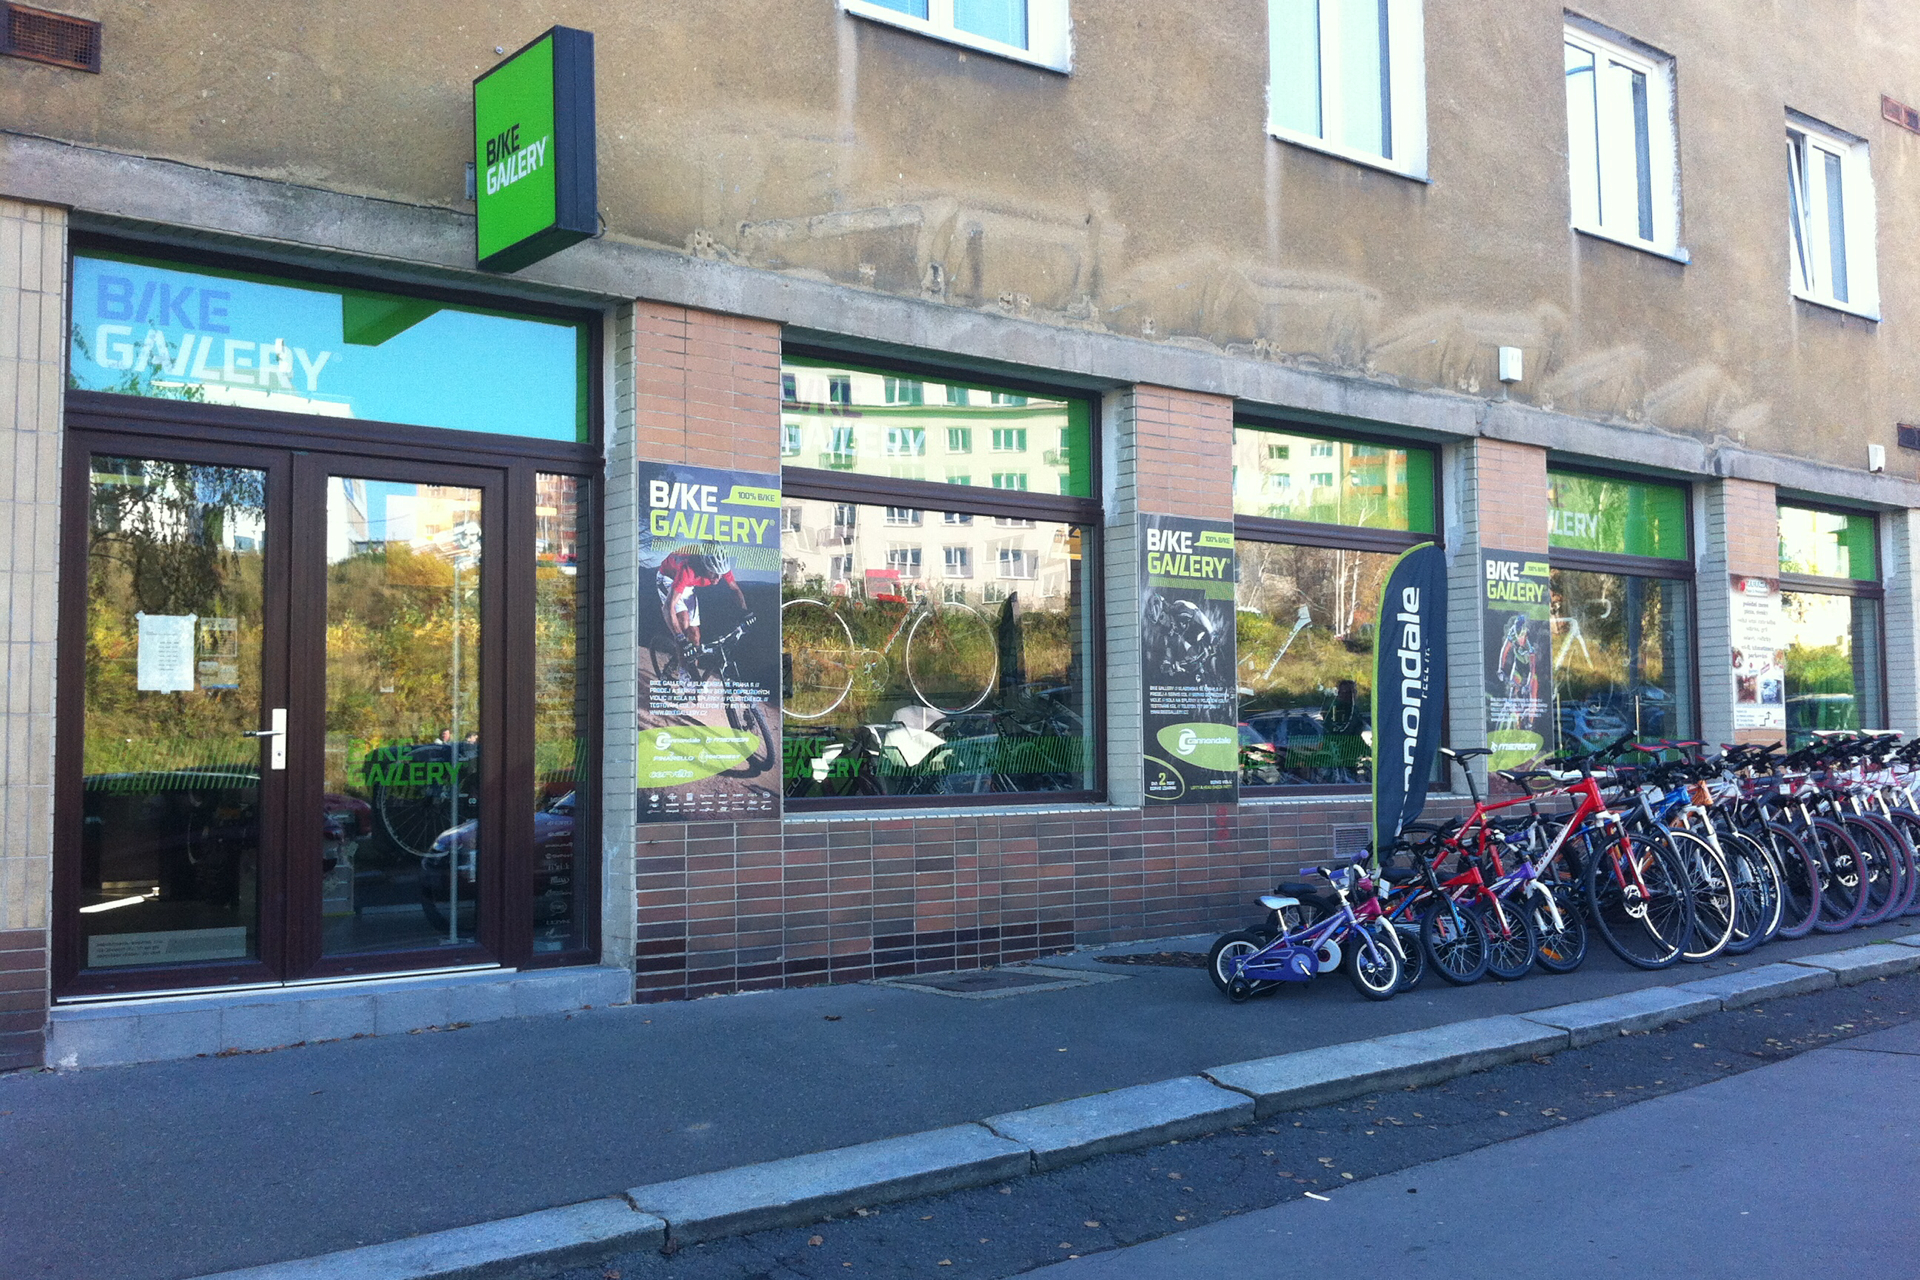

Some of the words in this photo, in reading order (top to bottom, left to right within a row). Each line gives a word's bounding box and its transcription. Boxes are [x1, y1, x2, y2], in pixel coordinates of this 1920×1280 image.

[487, 123, 521, 167] BIKE
[486, 135, 547, 196] GALLERY
[97, 274, 232, 334] BIKE
[95, 323, 332, 392] GALLERY
[649, 479, 718, 513] BIKE
[737, 491, 757, 501] 100%
[758, 493, 775, 502] BIKE
[650, 509, 770, 545] GALLERY
[1146, 528, 1193, 553] BIKE
[1147, 552, 1227, 579] GALLERY
[1486, 560, 1520, 581] BIKE
[1486, 580, 1545, 602] GALLERY
[348, 738, 414, 762] BIKE
[347, 762, 463, 787] GALLERY
[1158, 772, 1167, 786] 2
